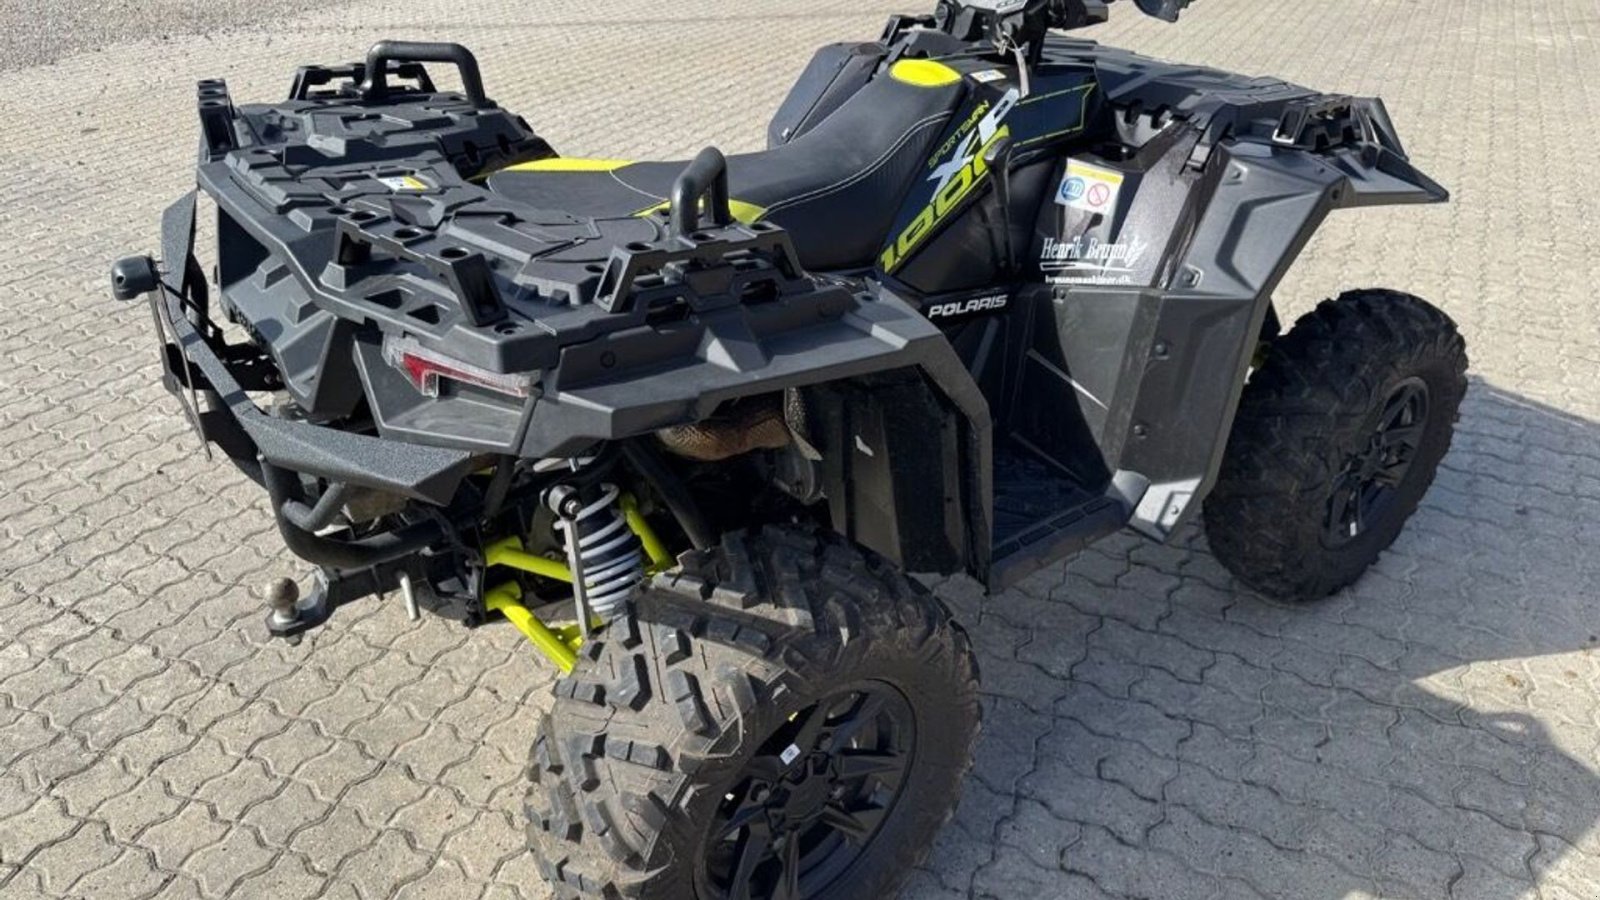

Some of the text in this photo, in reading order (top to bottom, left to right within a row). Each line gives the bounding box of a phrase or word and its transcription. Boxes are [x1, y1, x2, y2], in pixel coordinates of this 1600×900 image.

[927, 99, 990, 169] SPORTSMAN
[927, 88, 1020, 204] XP
[1040, 236, 1083, 260] Henrik
[927, 294, 1009, 319] POLARIS
